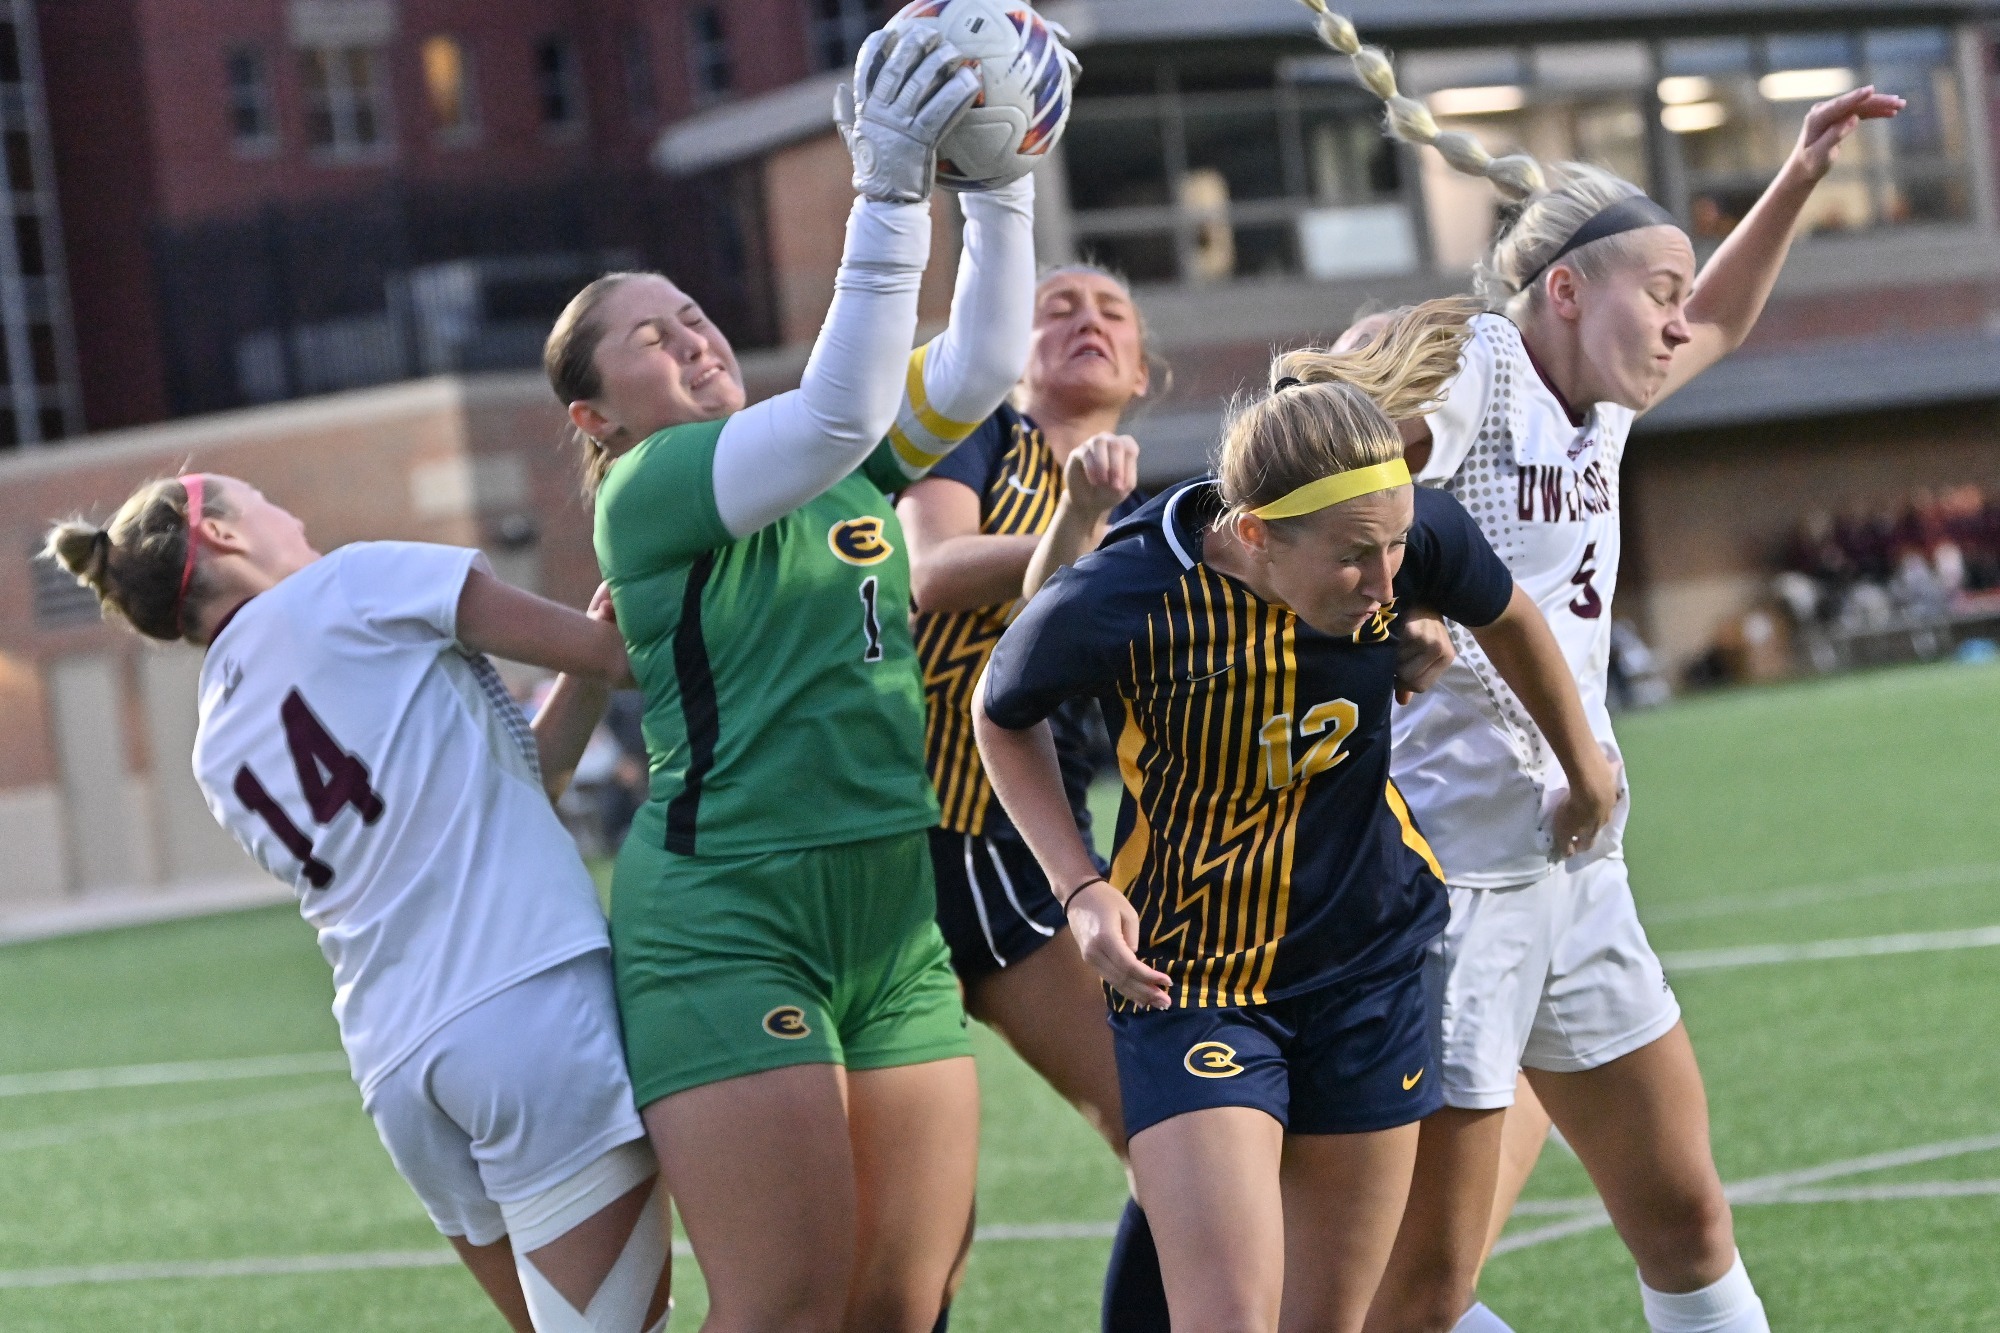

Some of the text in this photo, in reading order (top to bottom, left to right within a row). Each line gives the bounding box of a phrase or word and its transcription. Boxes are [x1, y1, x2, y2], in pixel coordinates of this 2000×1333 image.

[858, 575, 883, 663] 1
[232, 682, 385, 892] 14
[1259, 697, 1359, 790] 12
